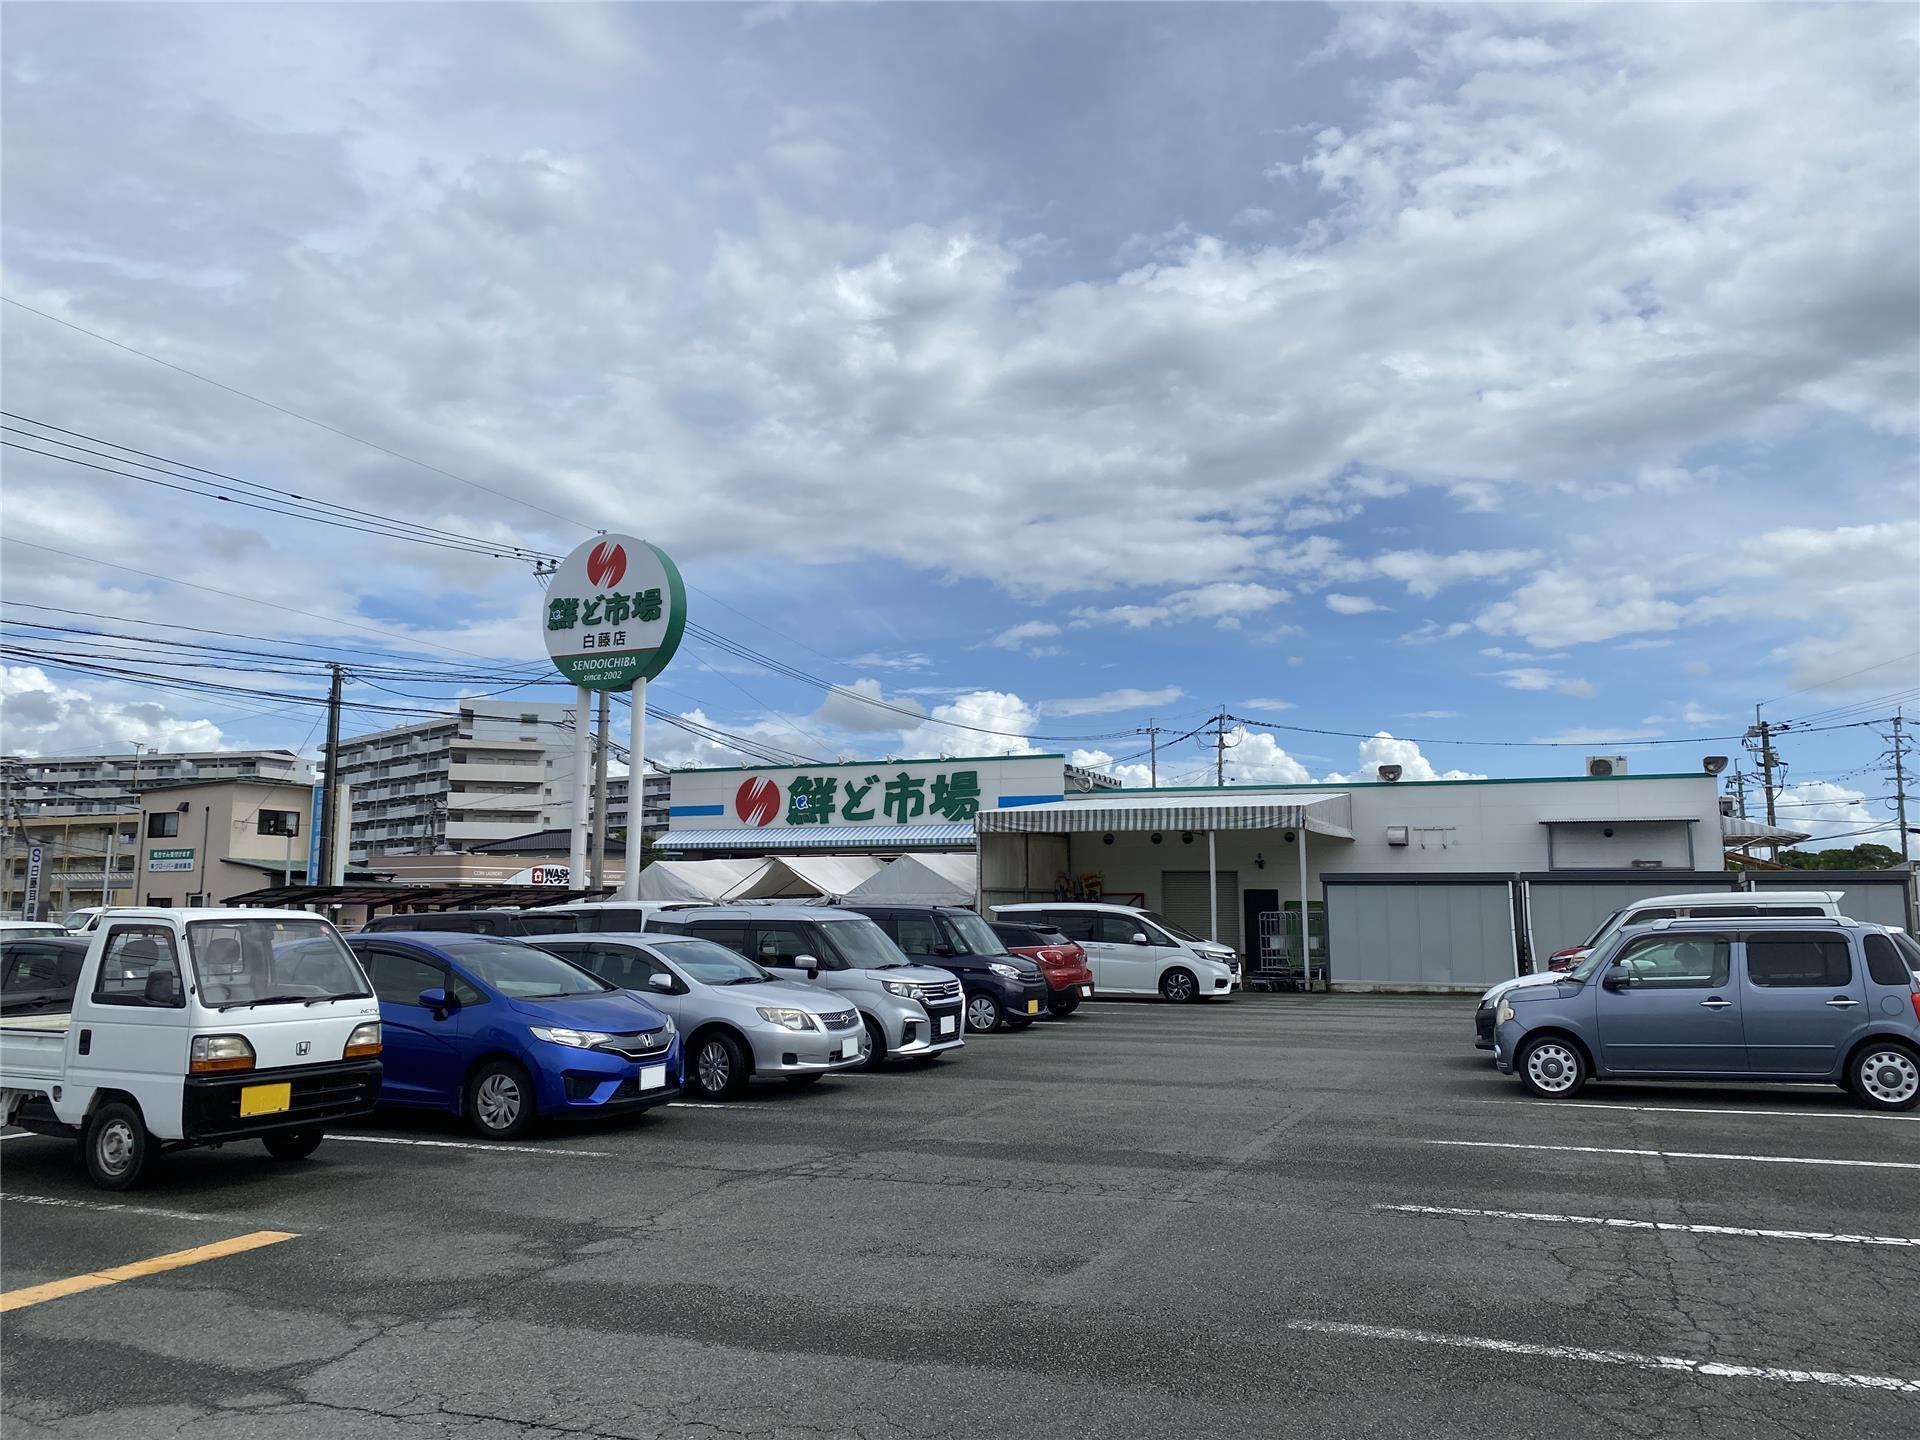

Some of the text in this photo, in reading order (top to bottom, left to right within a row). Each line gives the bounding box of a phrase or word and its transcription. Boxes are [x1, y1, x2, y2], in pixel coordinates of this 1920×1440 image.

[547, 588, 663, 631] 鮮ど市場
[583, 630, 626, 649] 白藤店
[572, 656, 636, 671] SENDOICHIBA
[583, 670, 622, 681] since 2002
[786, 770, 981, 826] 鮮ど市場
